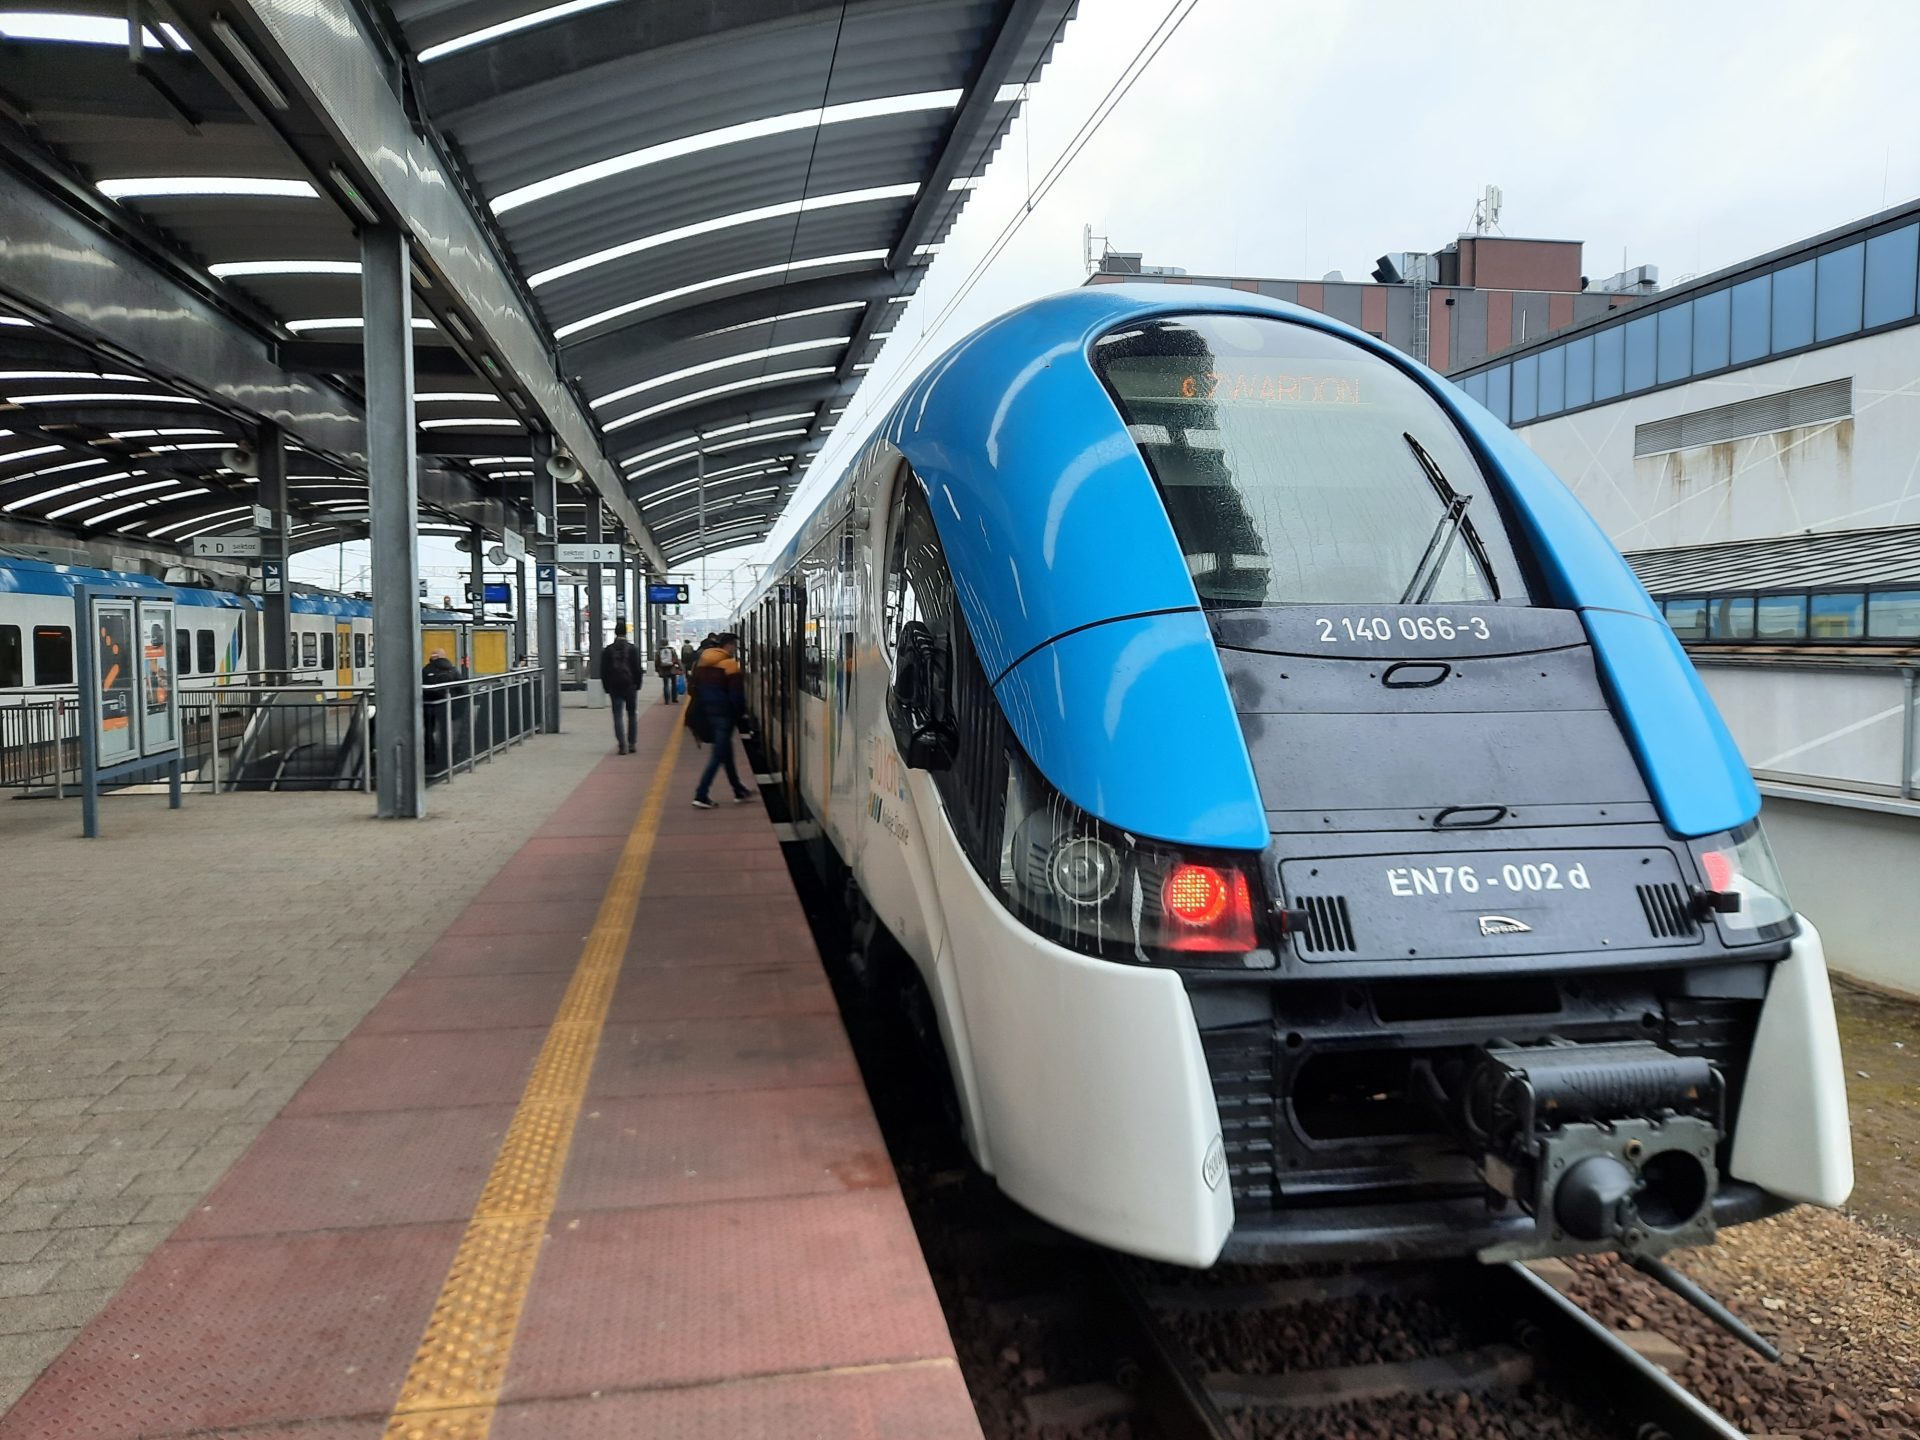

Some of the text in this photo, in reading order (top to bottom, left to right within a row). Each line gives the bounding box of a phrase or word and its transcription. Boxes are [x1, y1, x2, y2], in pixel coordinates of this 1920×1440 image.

[216, 543, 224, 553] D
[593, 550, 601, 559] D
[1315, 616, 1490, 642] 2 140 066-3
[1386, 866, 1480, 896] EN76
[1568, 862, 1592, 889] d
